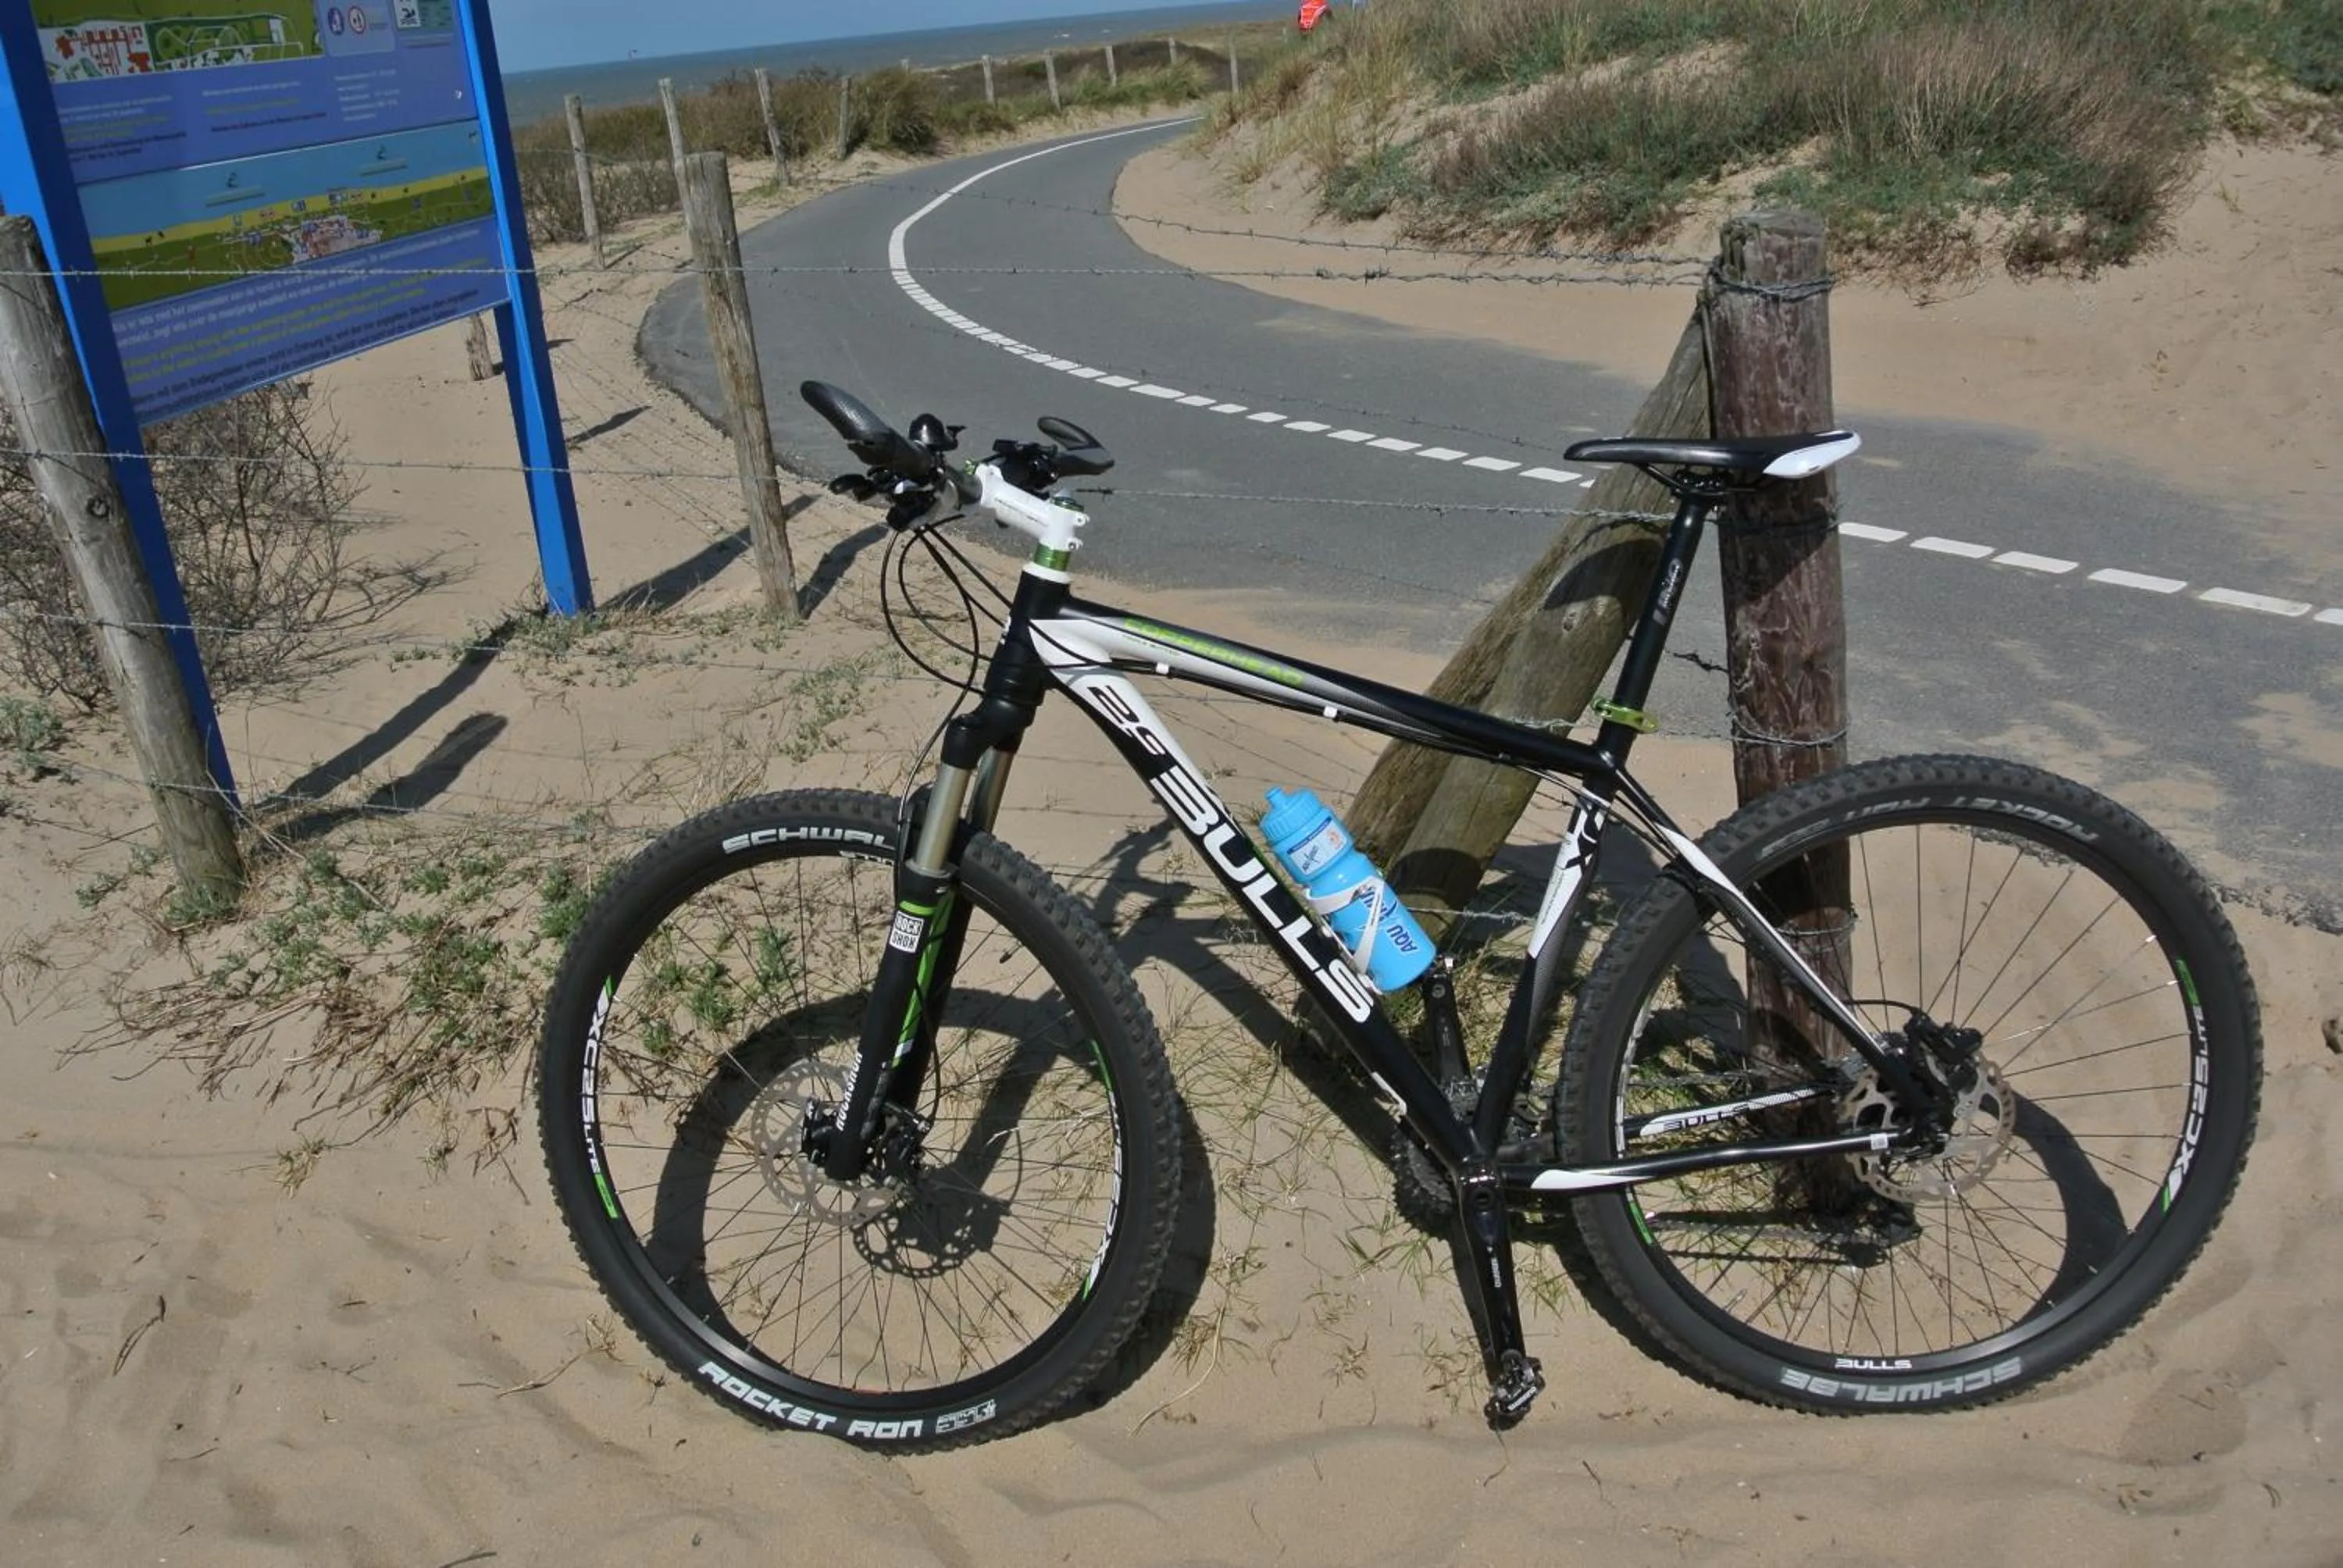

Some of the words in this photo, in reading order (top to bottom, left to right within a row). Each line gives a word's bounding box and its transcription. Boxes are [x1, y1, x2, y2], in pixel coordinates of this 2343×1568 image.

[722, 828, 895, 853] SCHWAL
[1949, 796, 2099, 842] ROCKET
[1150, 765, 1373, 1020] BULLS
[893, 914, 921, 935] ROCK
[1780, 1356, 2021, 1402] SCHWALBE
[1835, 1358, 1911, 1370] BULLS
[698, 1362, 836, 1430] ROCKET
[847, 1420, 923, 1438] RON
